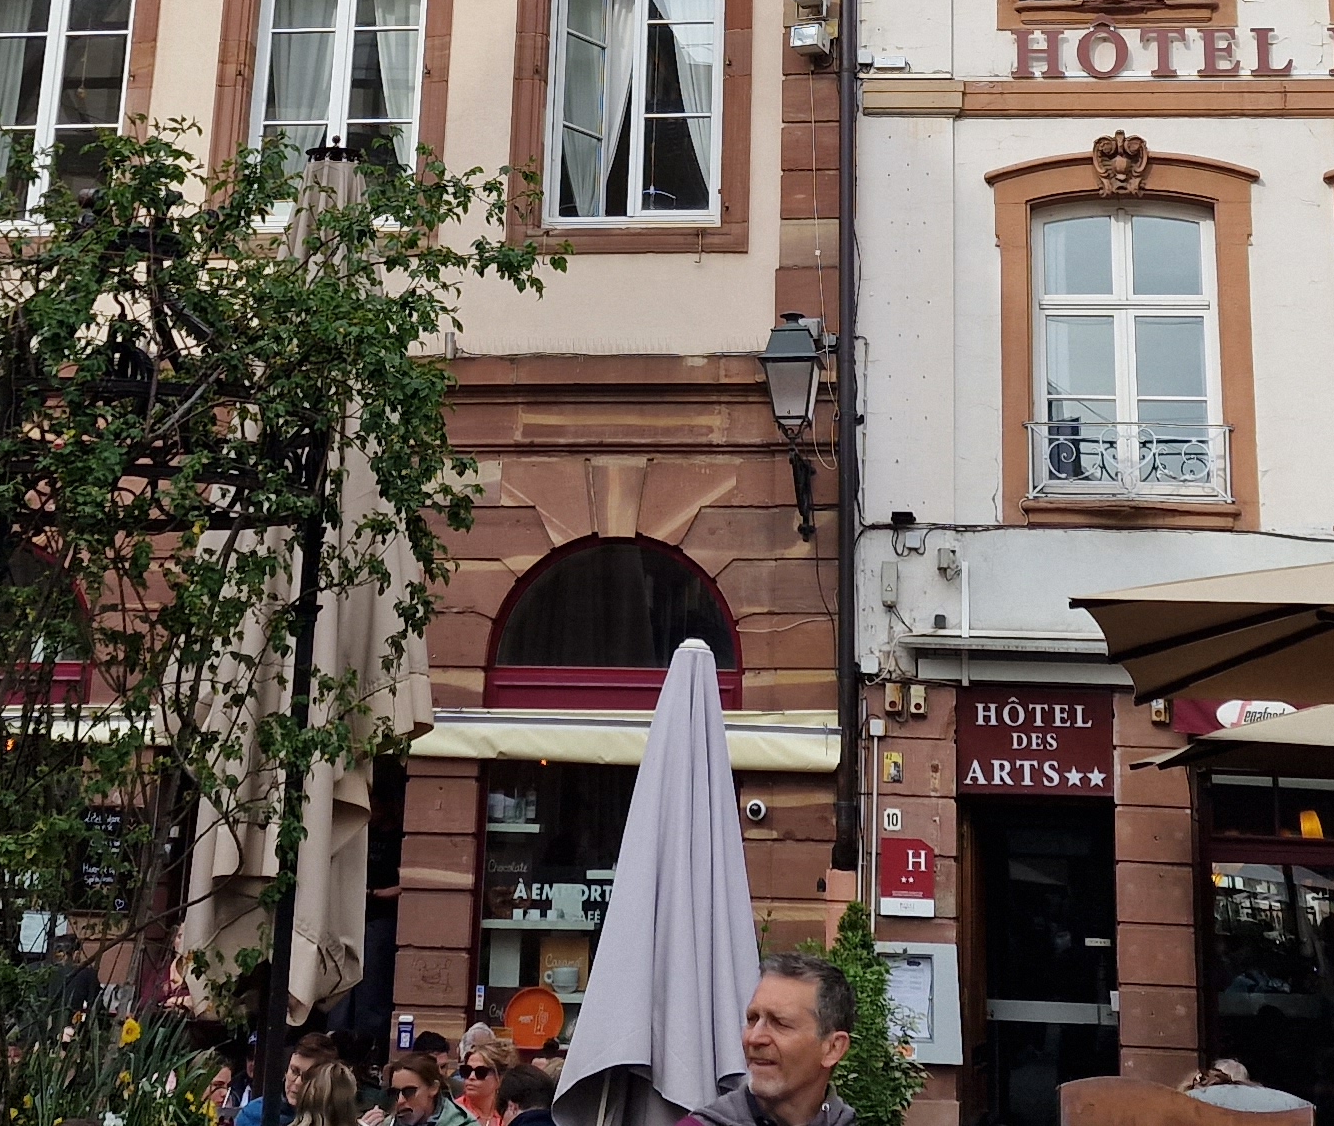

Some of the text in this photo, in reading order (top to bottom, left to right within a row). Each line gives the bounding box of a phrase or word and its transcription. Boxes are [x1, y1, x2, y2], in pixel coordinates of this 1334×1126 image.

[1011, 13, 1294, 78] HÔTEL
[974, 696, 1093, 728] HÔTEL
[1011, 732, 1058, 751] DES
[963, 759, 1061, 788] ARTS
[886, 812, 899, 827] 10
[906, 850, 928, 872] H
[513, 878, 528, 900] À
